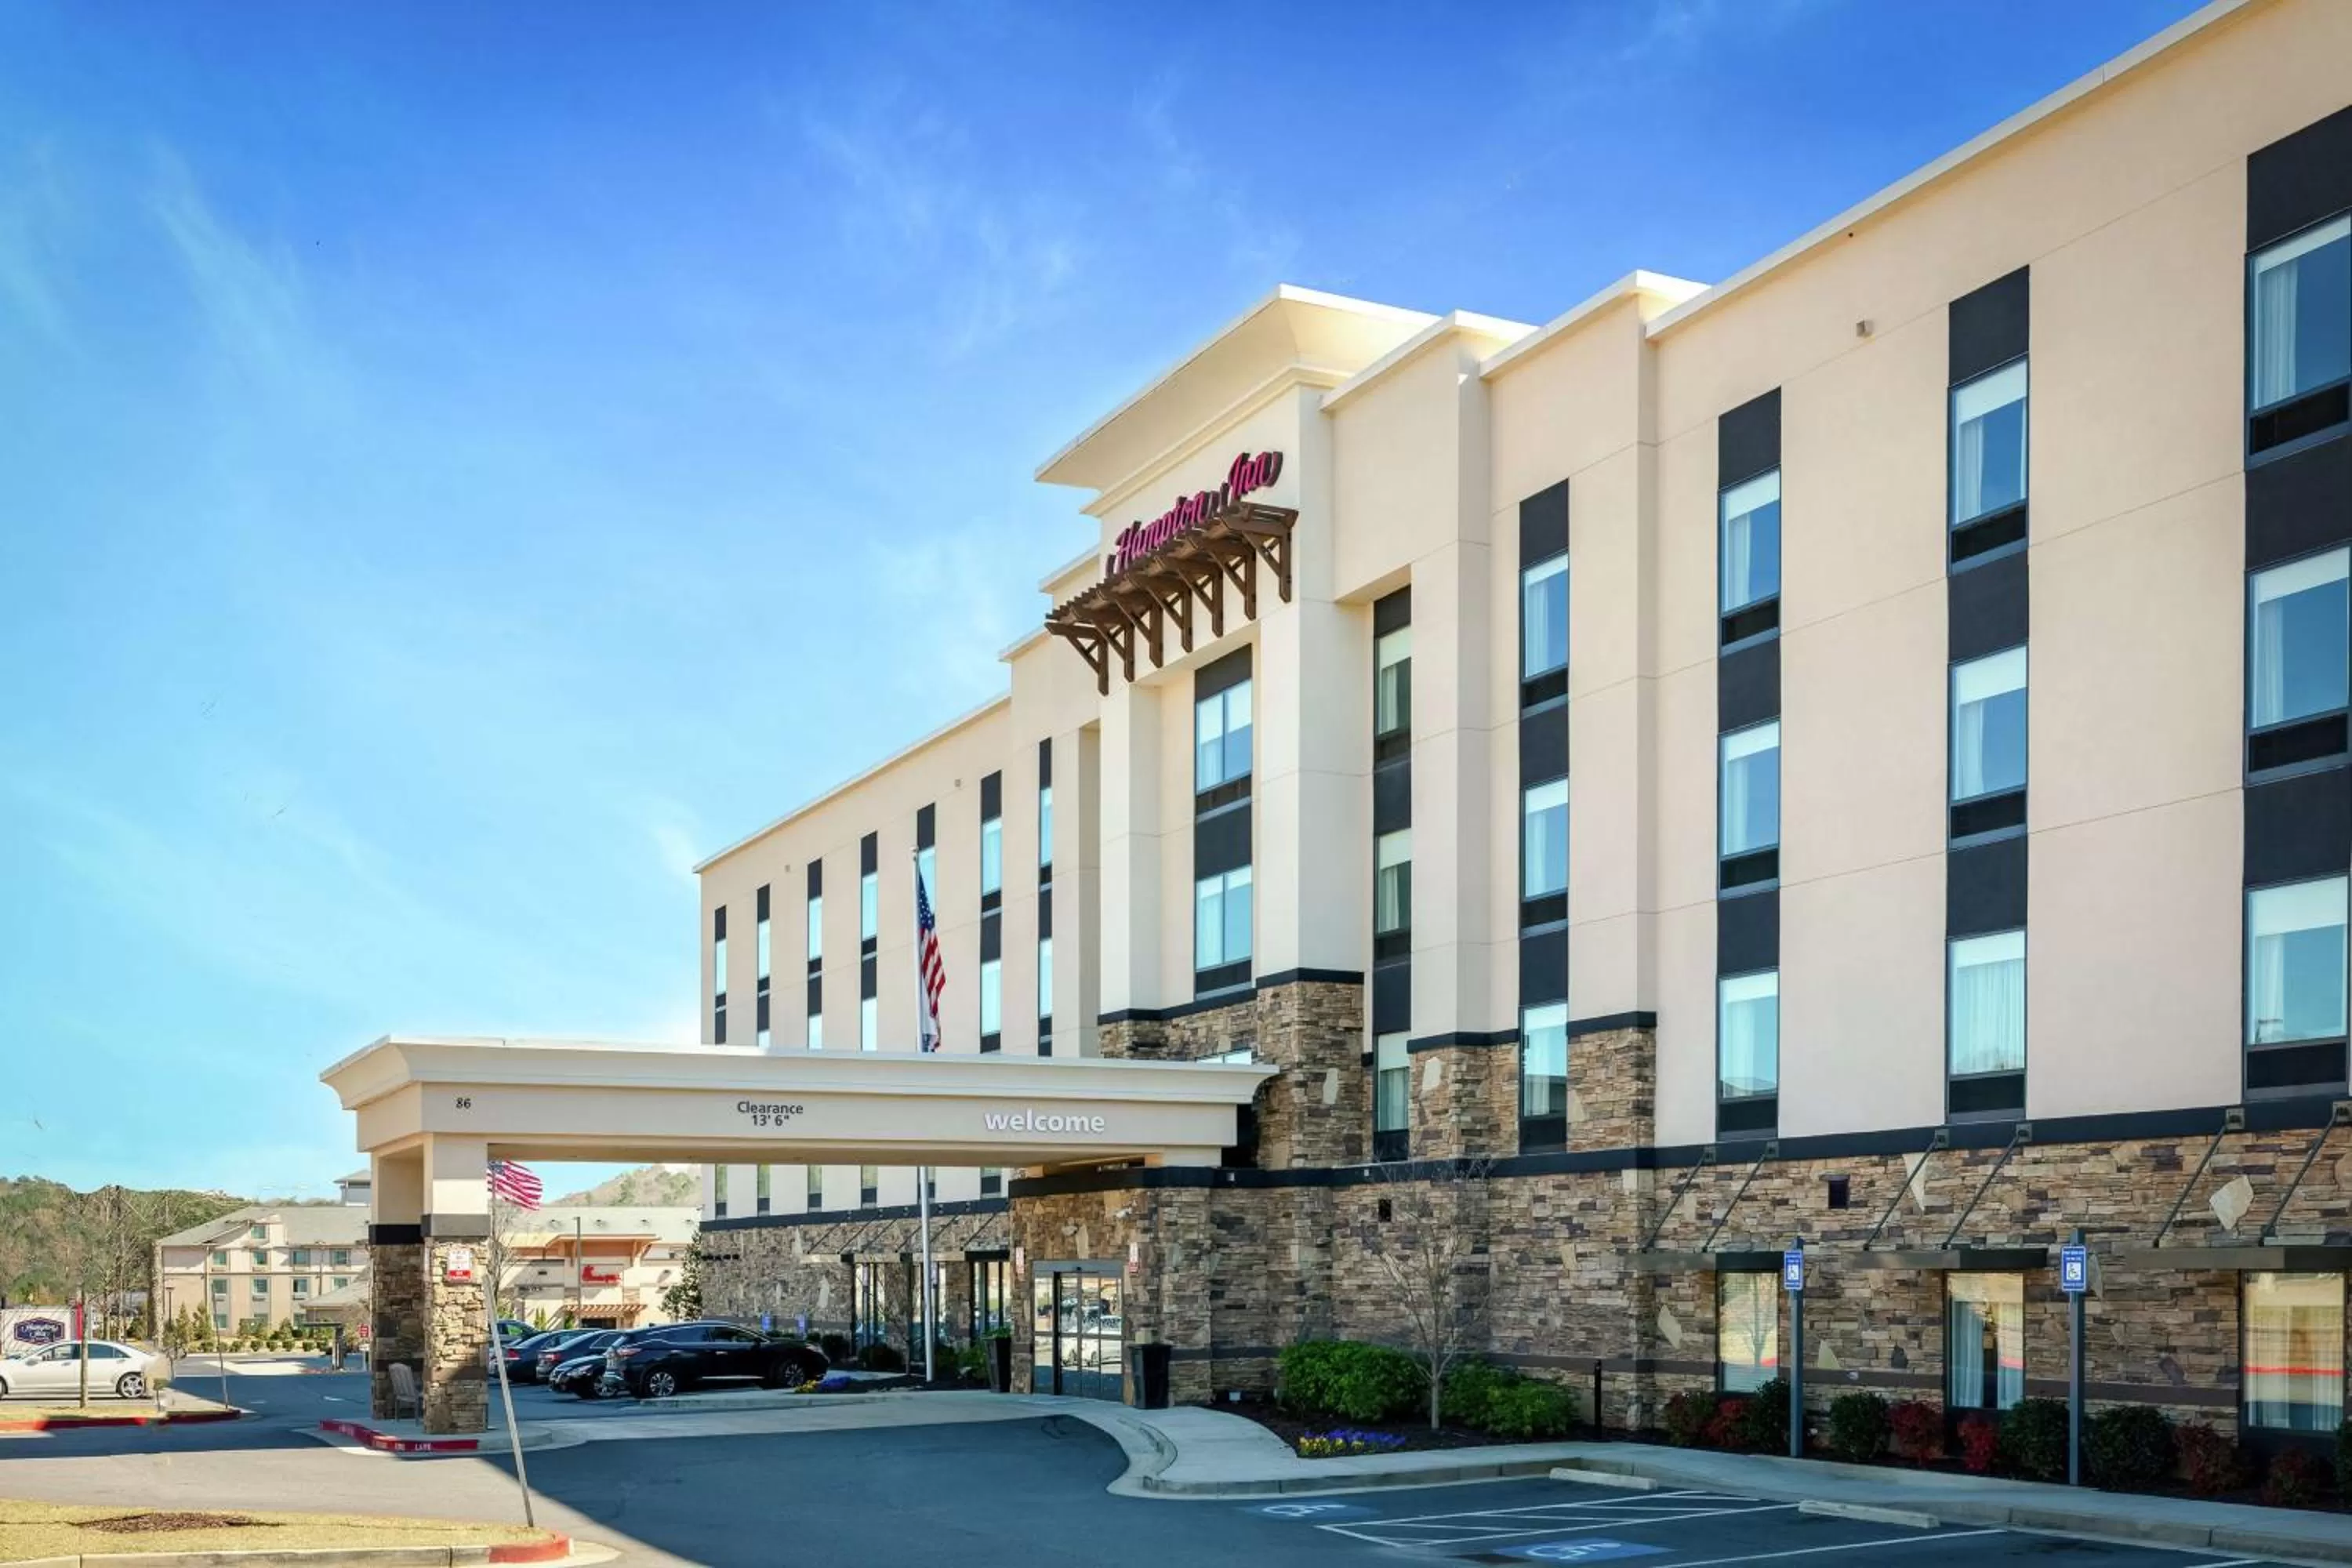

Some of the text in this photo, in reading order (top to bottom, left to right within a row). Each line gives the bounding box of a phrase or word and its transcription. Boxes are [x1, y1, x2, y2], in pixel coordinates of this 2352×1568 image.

[1106, 452, 1283, 577] Hampton Inn
[455, 1097, 471, 1109] 86
[737, 1101, 804, 1114] Clearance
[752, 1114, 789, 1126] 13' 6"
[984, 1109, 1105, 1132] welcome
